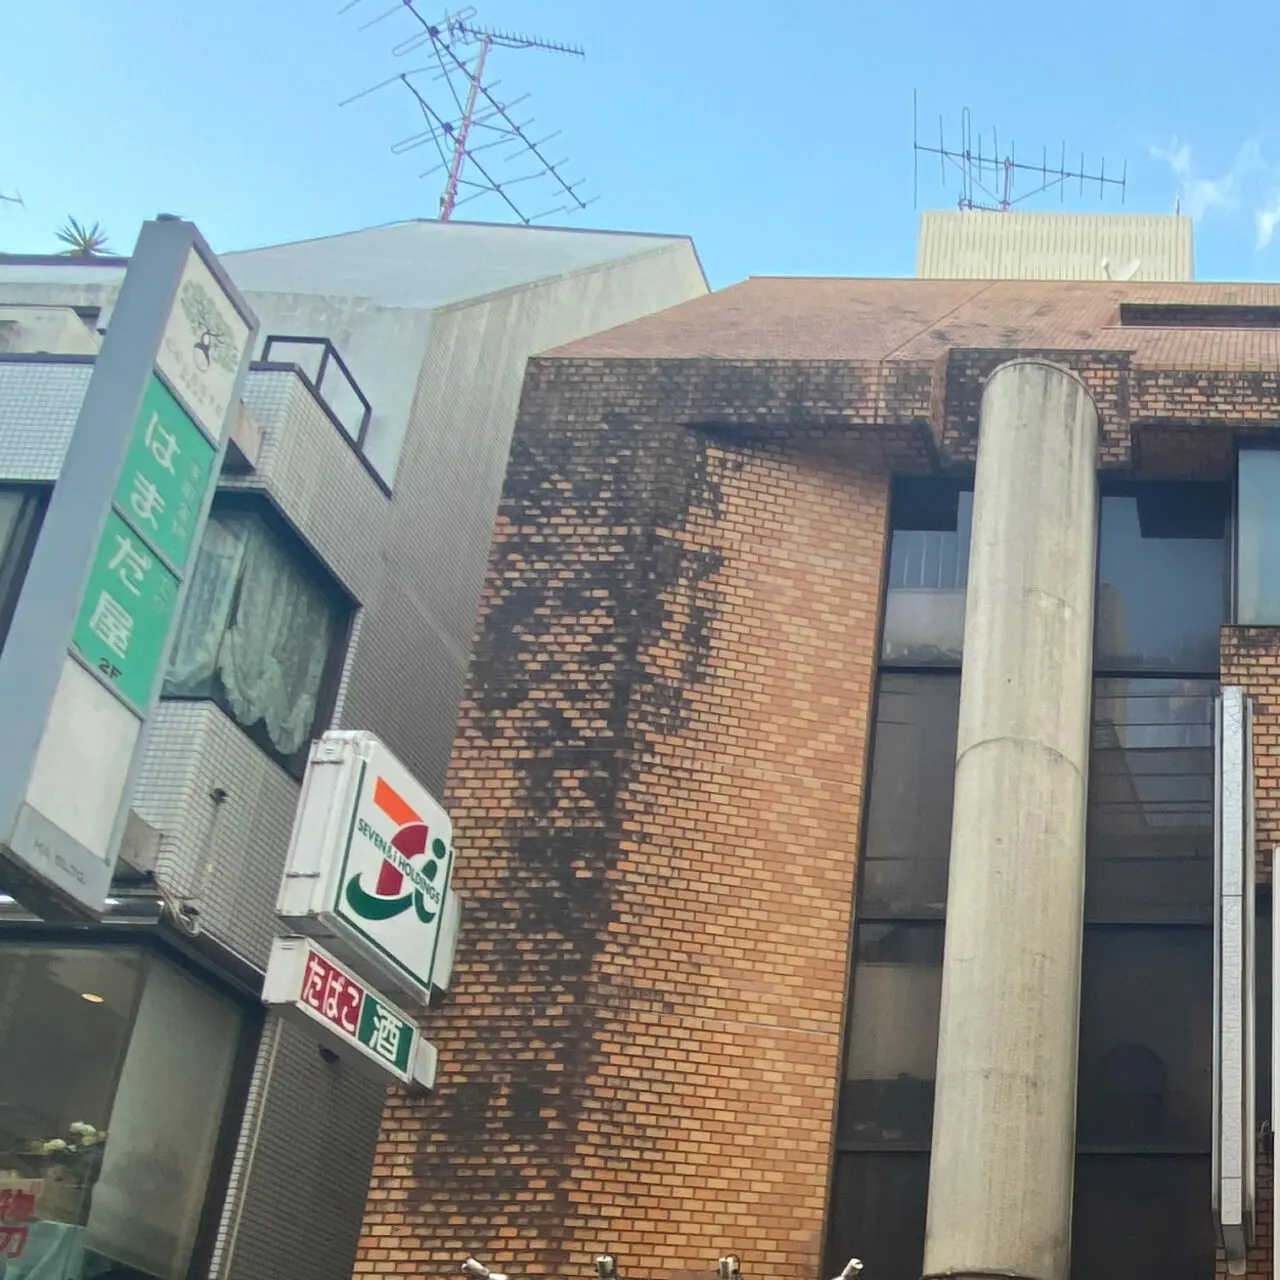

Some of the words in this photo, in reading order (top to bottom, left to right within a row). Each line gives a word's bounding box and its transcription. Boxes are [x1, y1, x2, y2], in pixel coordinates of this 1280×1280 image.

[89, 411, 181, 659] はまだ屋
[98, 657, 123, 680] 2F
[398, 858, 441, 904] HOLDINGS
[303, 955, 358, 1033] たばこ
[369, 1003, 403, 1063] 酒
